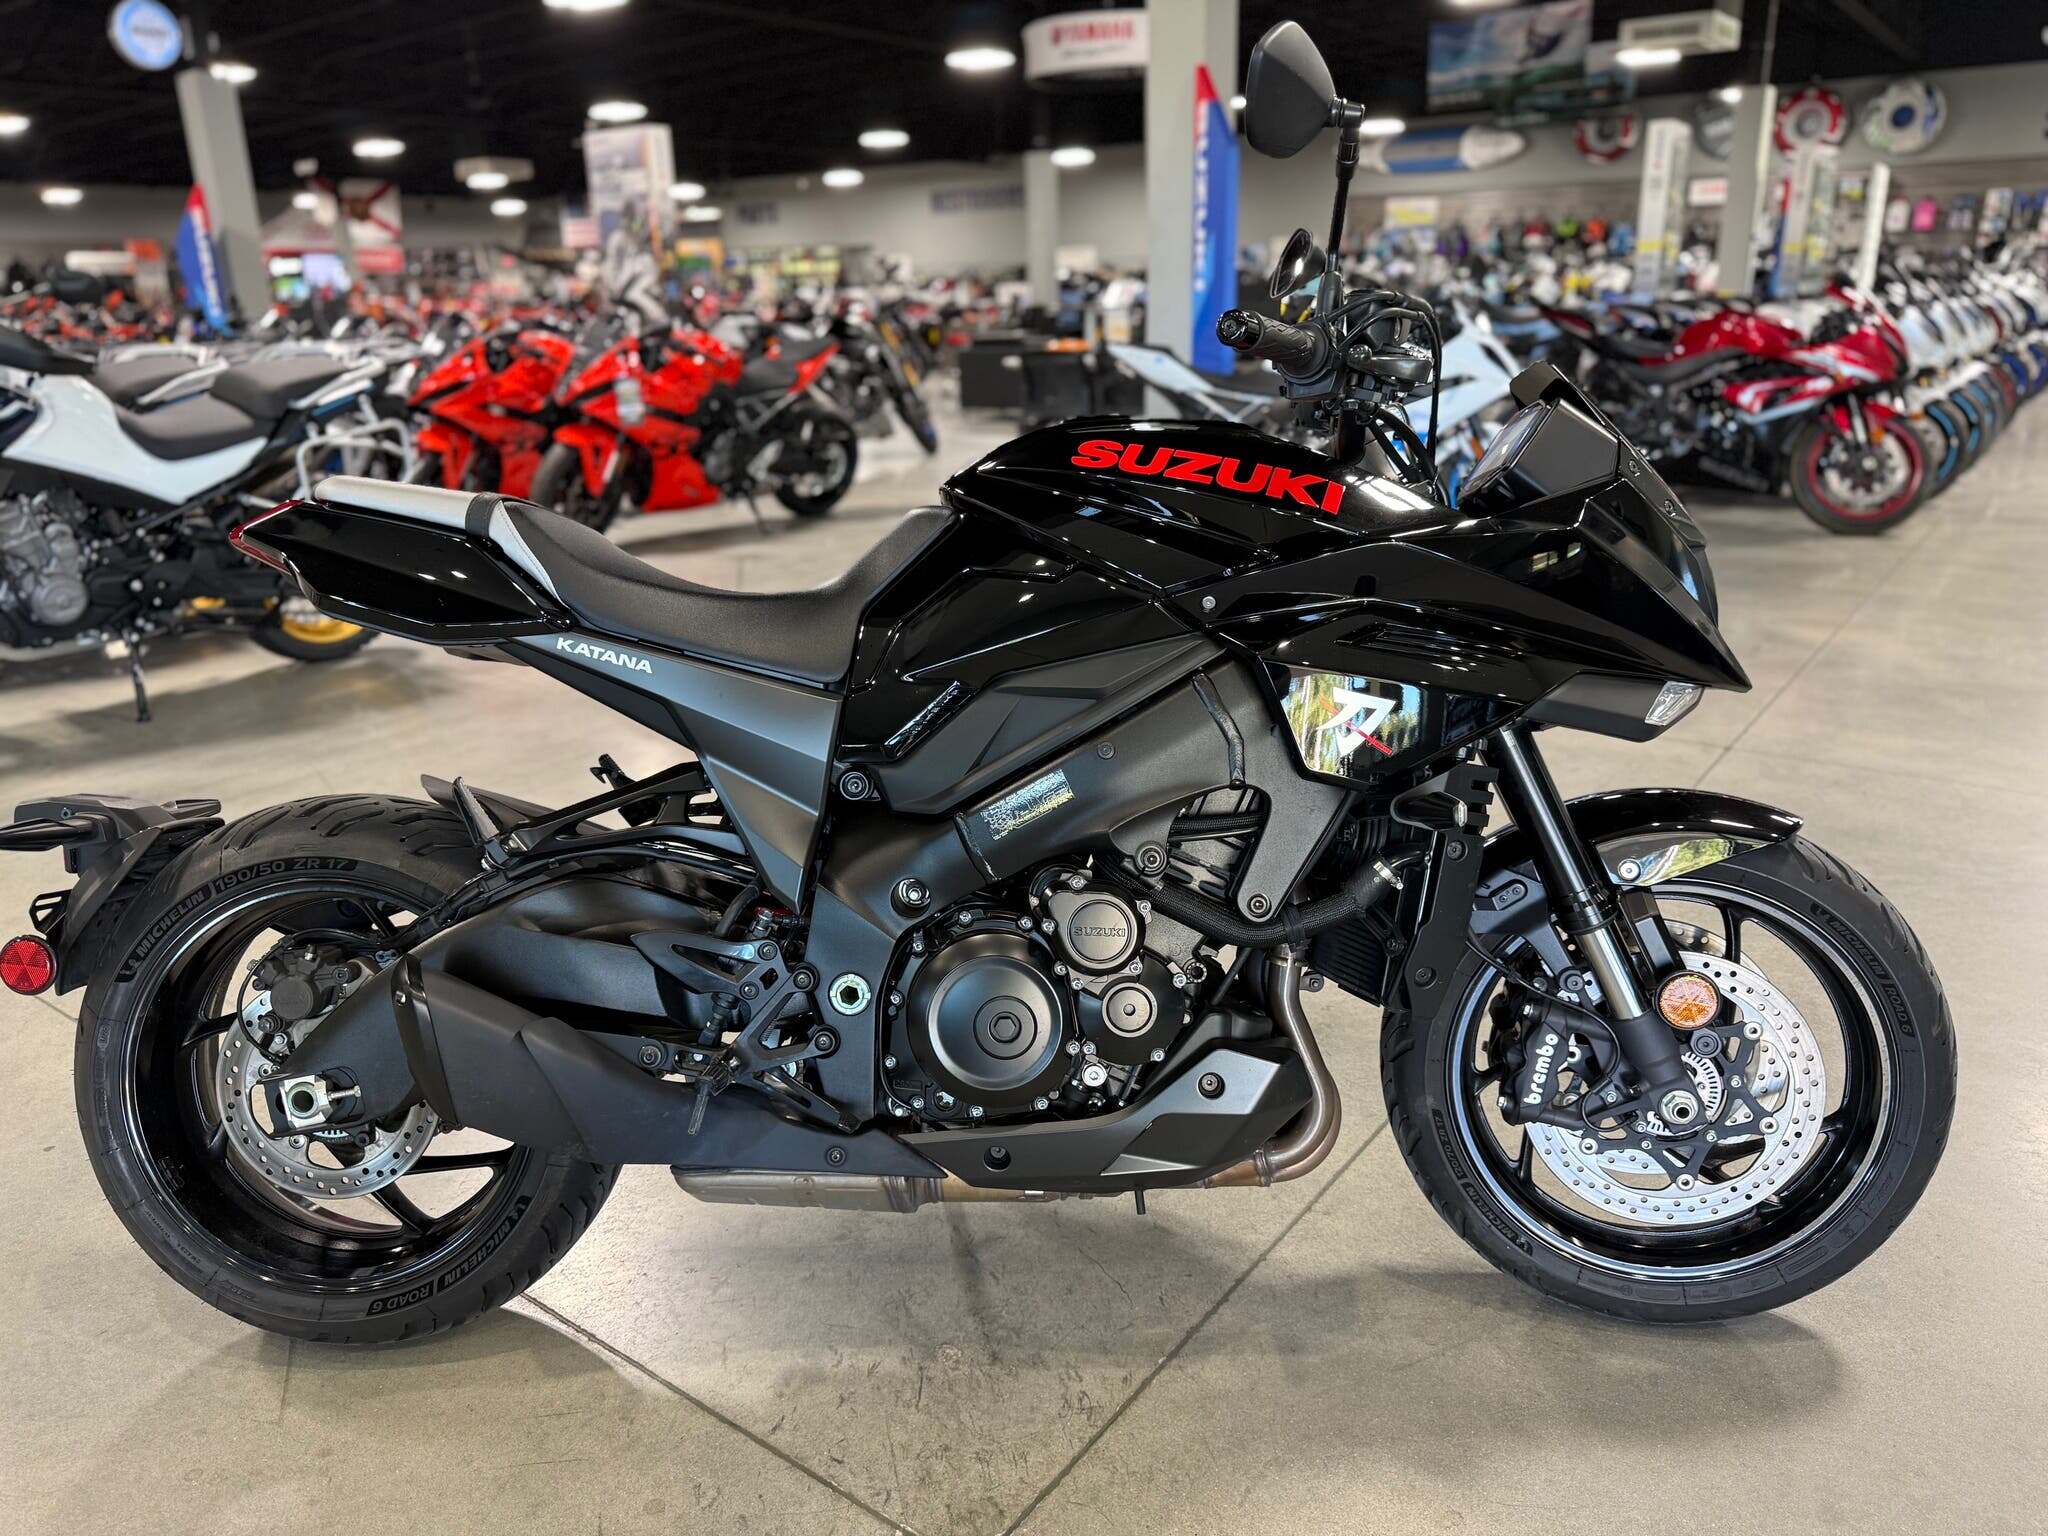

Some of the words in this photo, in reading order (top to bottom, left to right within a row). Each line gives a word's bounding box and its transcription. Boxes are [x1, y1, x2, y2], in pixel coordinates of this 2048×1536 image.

[1071, 440, 1346, 515] SUZUKI
[556, 637, 653, 674] KATANA
[135, 893, 206, 958] MICHELIN
[215, 860, 286, 895] 190/50
[292, 858, 321, 870] ZR
[326, 858, 350, 870] 17
[1073, 926, 1126, 938] SUZUKI
[1830, 919, 1886, 979] MICHELIN
[1885, 985, 1908, 1022] ROAD
[1523, 1033, 1559, 1105] brembo
[1465, 1184, 1518, 1240] MICHELIN
[444, 1217, 514, 1286] MICHELIN
[372, 1301, 384, 1312] 6
[387, 1285, 431, 1309] ROAD
